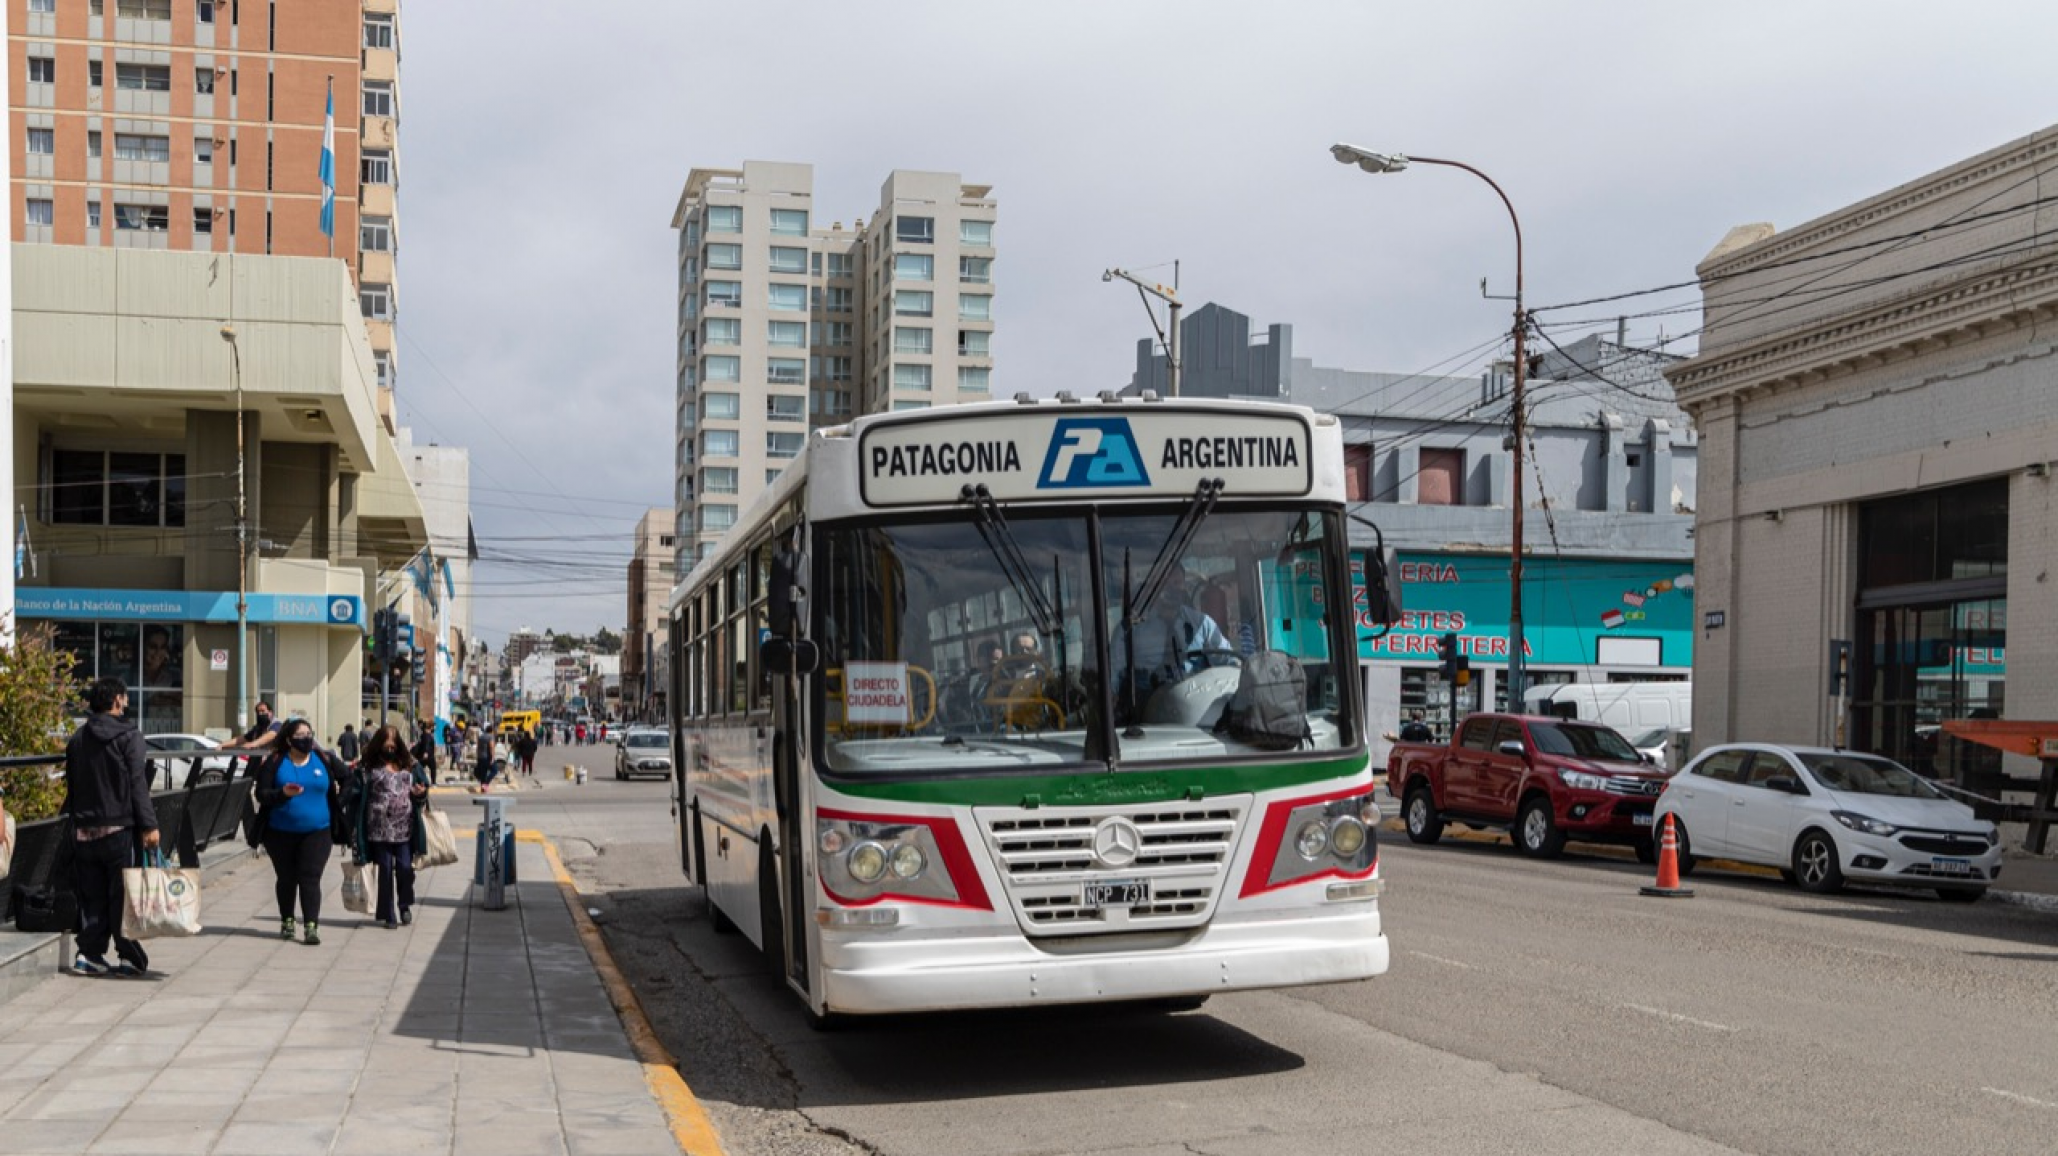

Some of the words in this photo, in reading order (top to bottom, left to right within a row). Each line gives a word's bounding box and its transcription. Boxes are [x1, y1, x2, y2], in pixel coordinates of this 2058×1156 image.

[872, 440, 1021, 478] PATAGONIA
[1161, 437, 1298, 469] ARGENTINA
[16, 600, 50, 610] Banco
[53, 600, 66, 610] de
[69, 600, 79, 611] la
[82, 600, 122, 611] Nación
[126, 601, 182, 613] Argentina
[279, 601, 319, 617] BNA
[1372, 634, 1532, 656] FERRTERA
[853, 678, 900, 691] DIRECTO
[848, 694, 906, 707] CIUDADELA
[1086, 885, 1113, 903] NCP
[1121, 884, 1148, 902] 731
